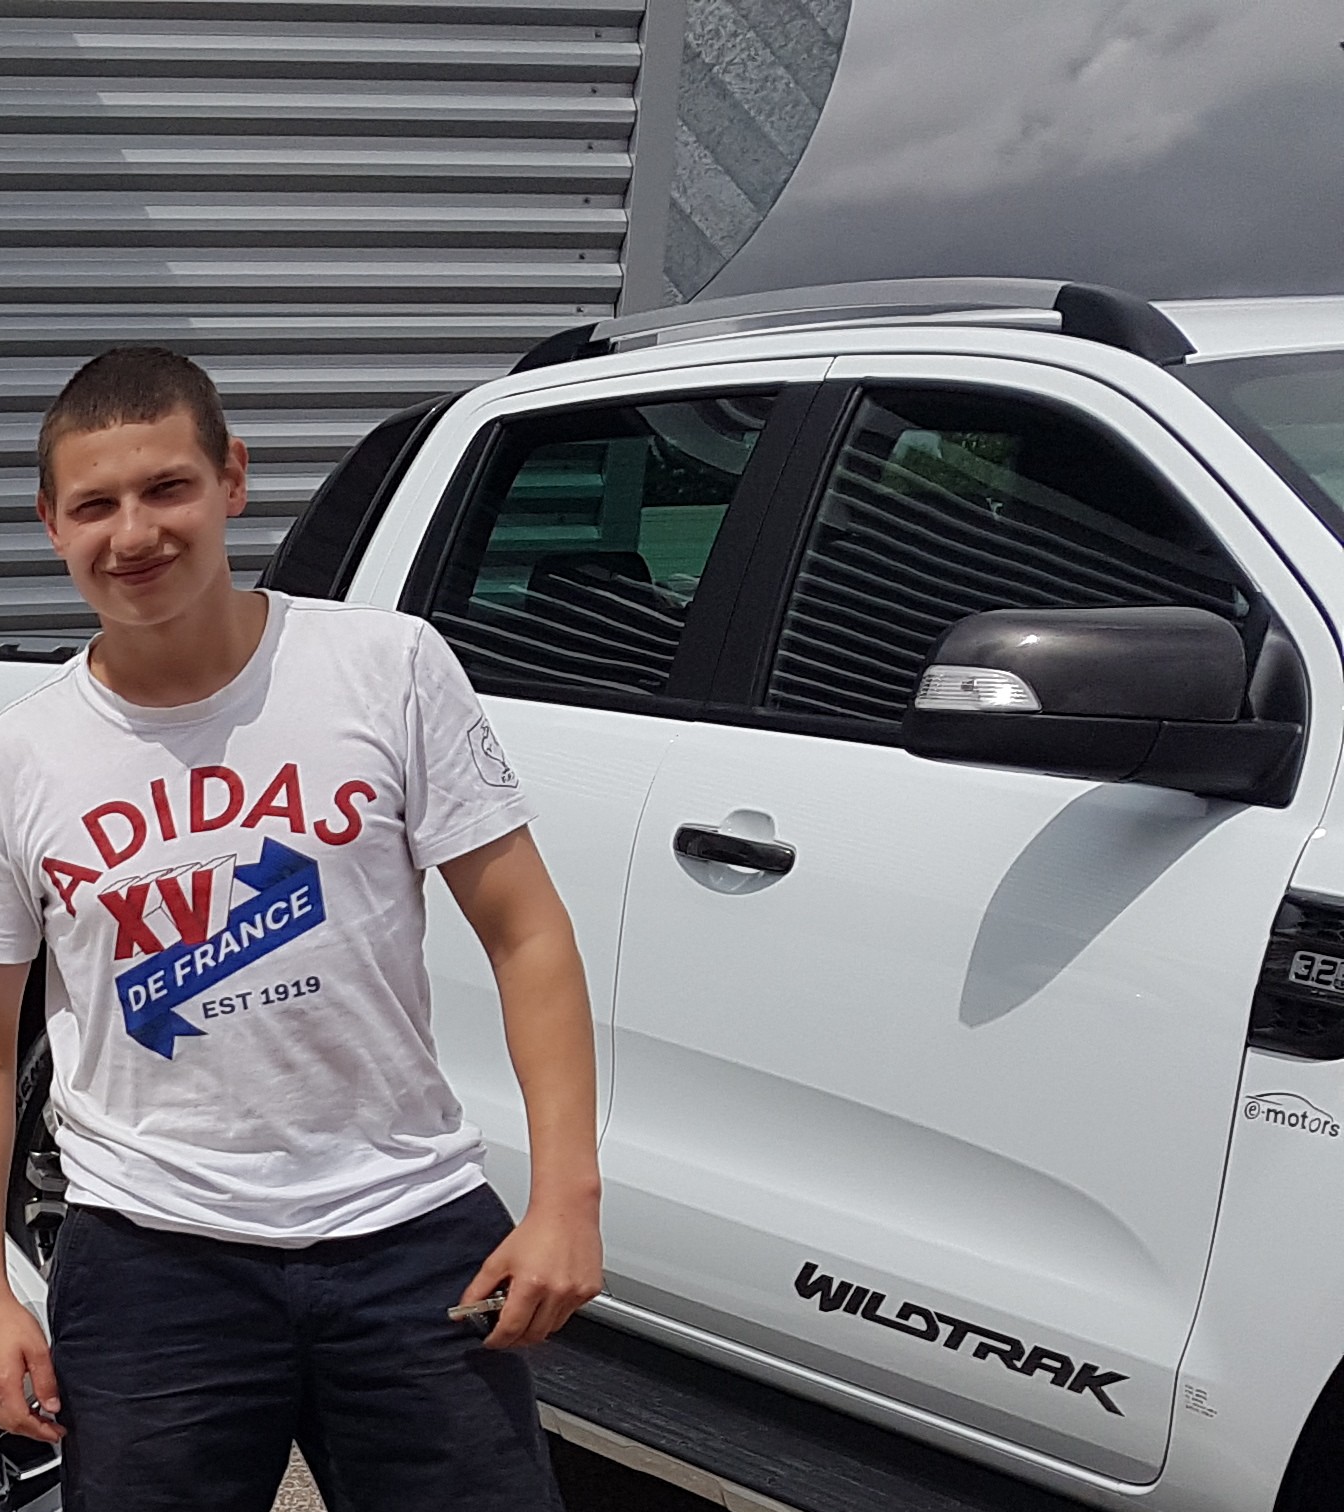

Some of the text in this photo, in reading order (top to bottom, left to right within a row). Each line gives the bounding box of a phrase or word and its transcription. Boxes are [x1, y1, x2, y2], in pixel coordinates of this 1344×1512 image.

[42, 763, 377, 918] ADIDAS
[98, 862, 224, 960] XV
[128, 885, 312, 1012] DE FRANCE
[202, 975, 321, 1019] EST 1919
[794, 1261, 1130, 1417] WILDTRAK
